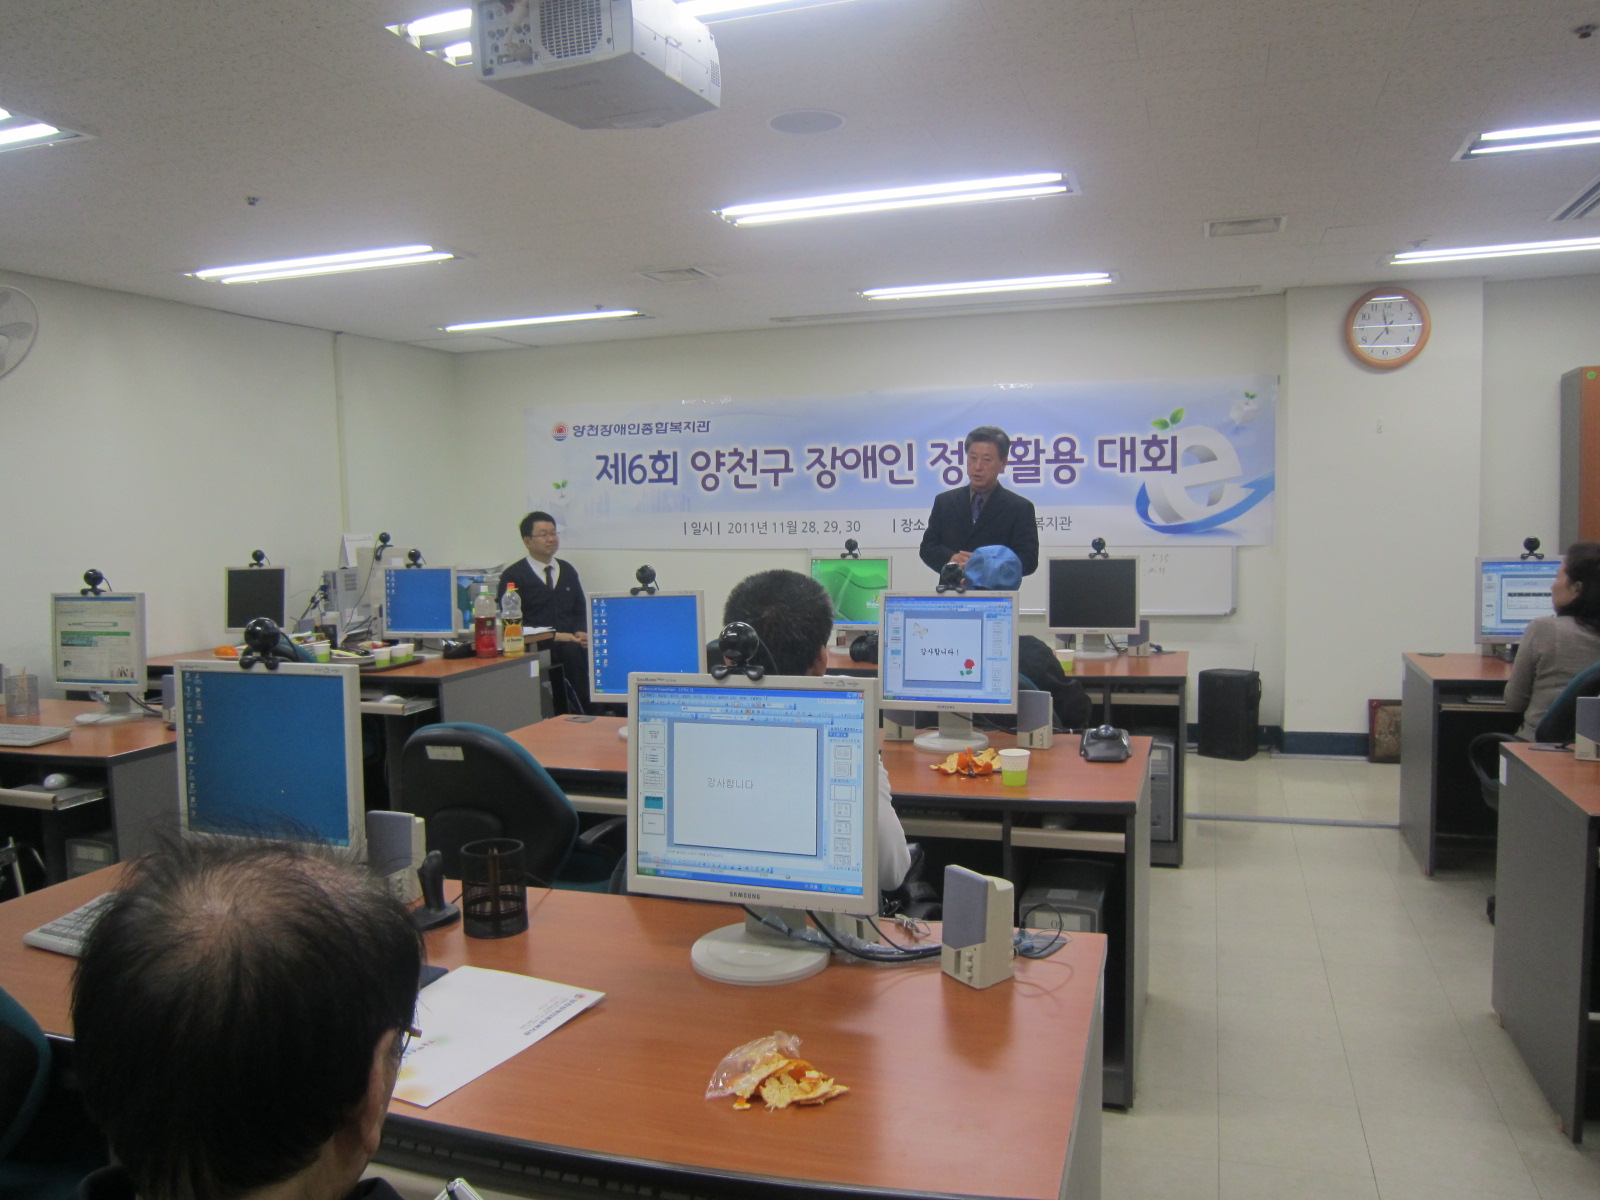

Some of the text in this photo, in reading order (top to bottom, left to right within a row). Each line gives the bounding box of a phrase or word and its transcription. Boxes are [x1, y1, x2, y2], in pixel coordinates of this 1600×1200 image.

[572, 420, 712, 438] 양천장애인종합복지관
[595, 433, 1178, 492] 제6회 양천구 장애인 정활용 대회
[727, 520, 768, 535] 2011년
[772, 520, 798, 535] 11월
[801, 521, 820, 535] 28,
[823, 520, 842, 535] 29,
[845, 520, 861, 533] 30
[729, 891, 761, 900] SAMSUNG
